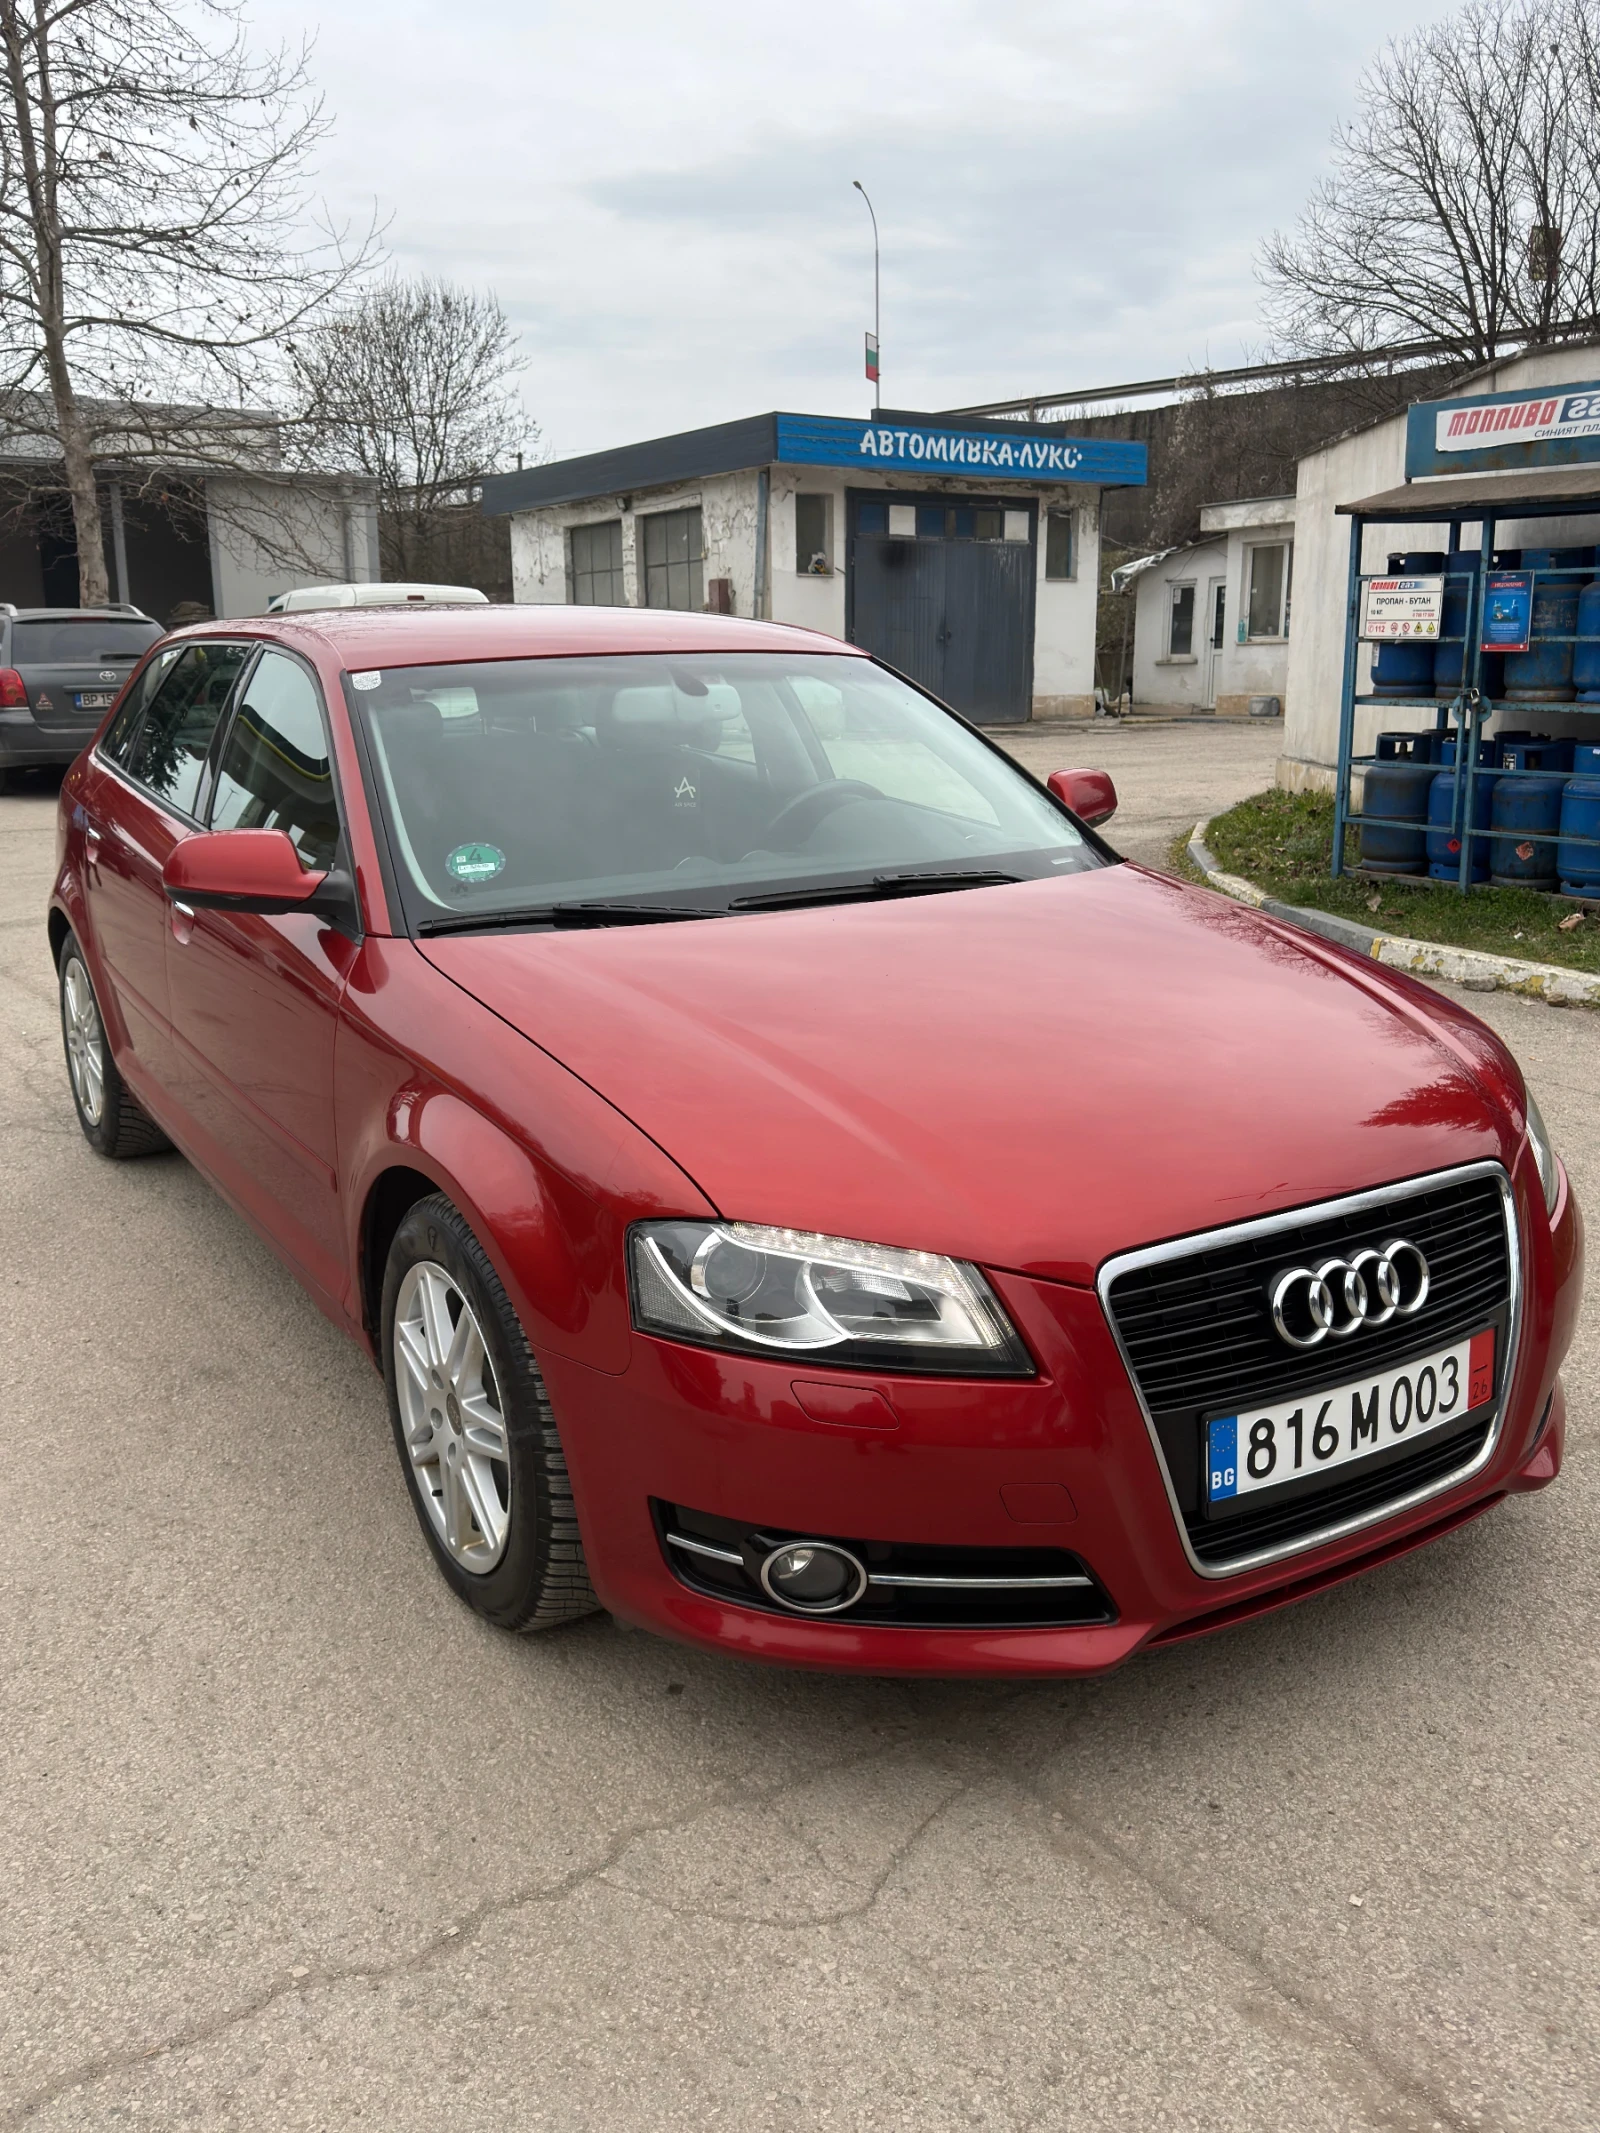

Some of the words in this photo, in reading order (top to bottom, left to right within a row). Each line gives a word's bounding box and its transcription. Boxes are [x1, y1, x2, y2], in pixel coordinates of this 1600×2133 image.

[1534, 426, 1580, 438] СИНИЯТ
[1582, 423, 1600, 433] ПЛ
[1376, 597, 1404, 605] ПРОПАН
[1409, 597, 1431, 605] БУТАН
[1375, 625, 1385, 633] 112
[83, 695, 97, 705] BP
[469, 847, 482, 862] 4
[1211, 1467, 1235, 1490] BG
[1473, 1379, 1487, 1400] 26
